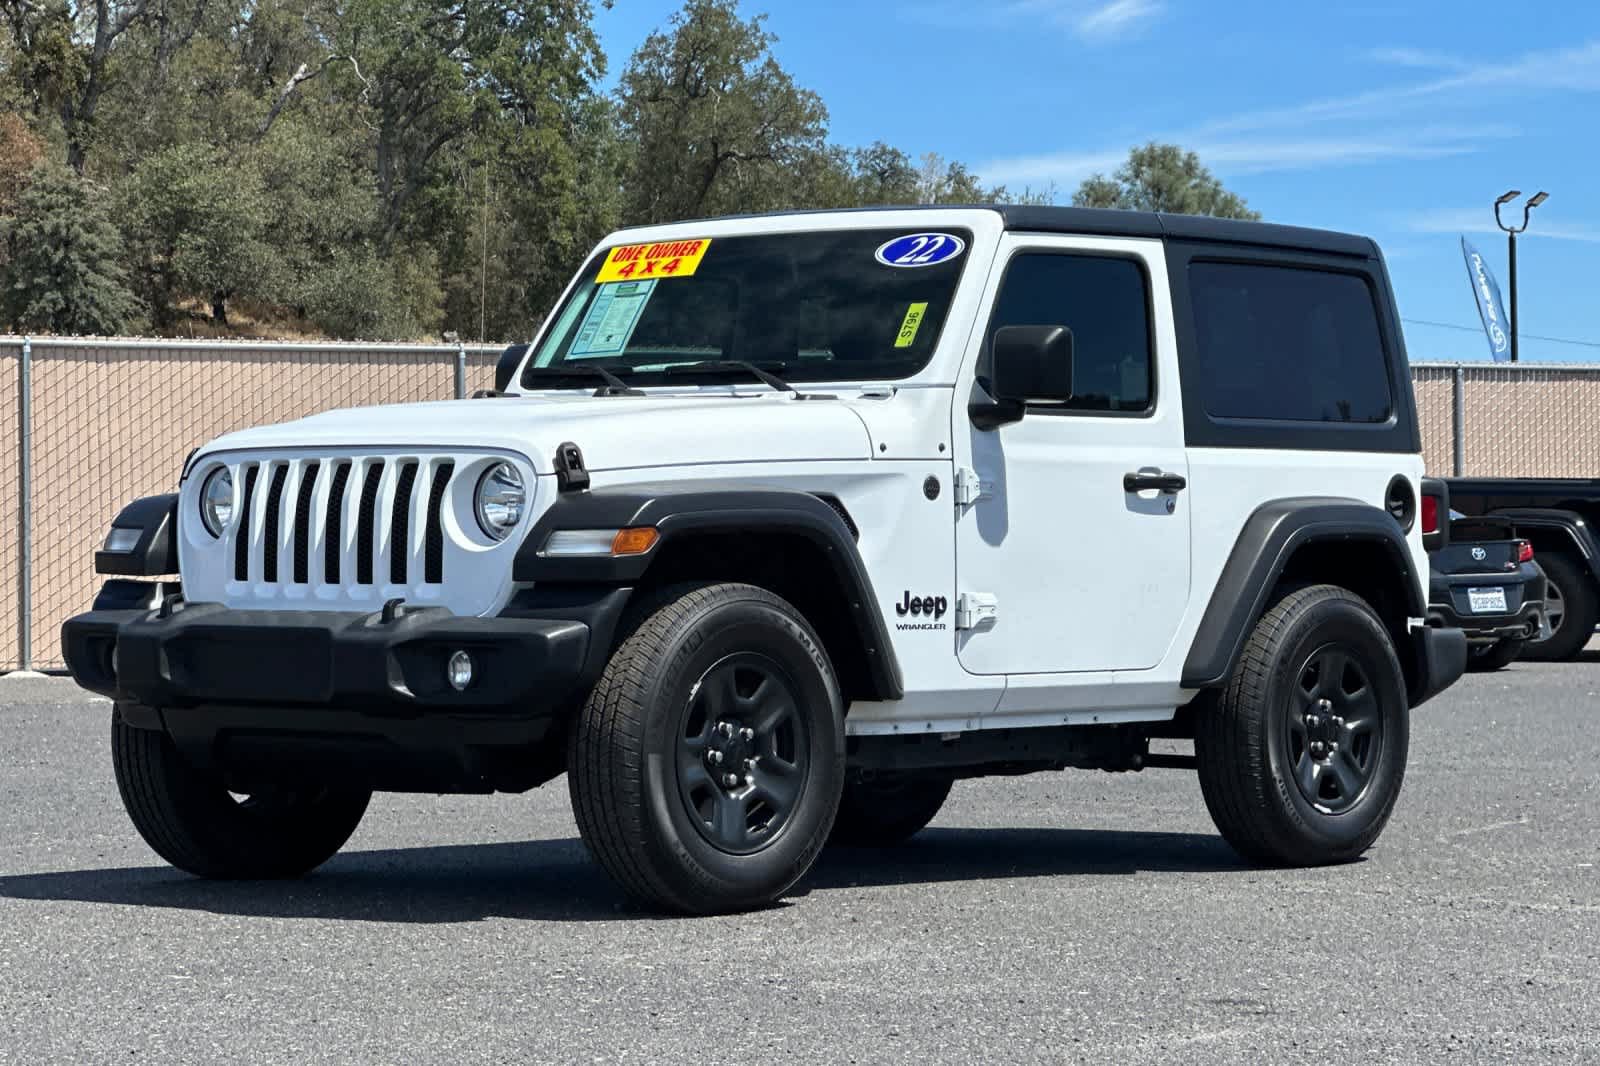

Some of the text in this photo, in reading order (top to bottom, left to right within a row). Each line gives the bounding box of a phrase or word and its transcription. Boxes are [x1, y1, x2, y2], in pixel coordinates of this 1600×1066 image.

[612, 240, 703, 262] ONE OWNER
[894, 236, 946, 263] 22
[896, 590, 947, 621] Jeep
[896, 623, 947, 631] WRANGLER
